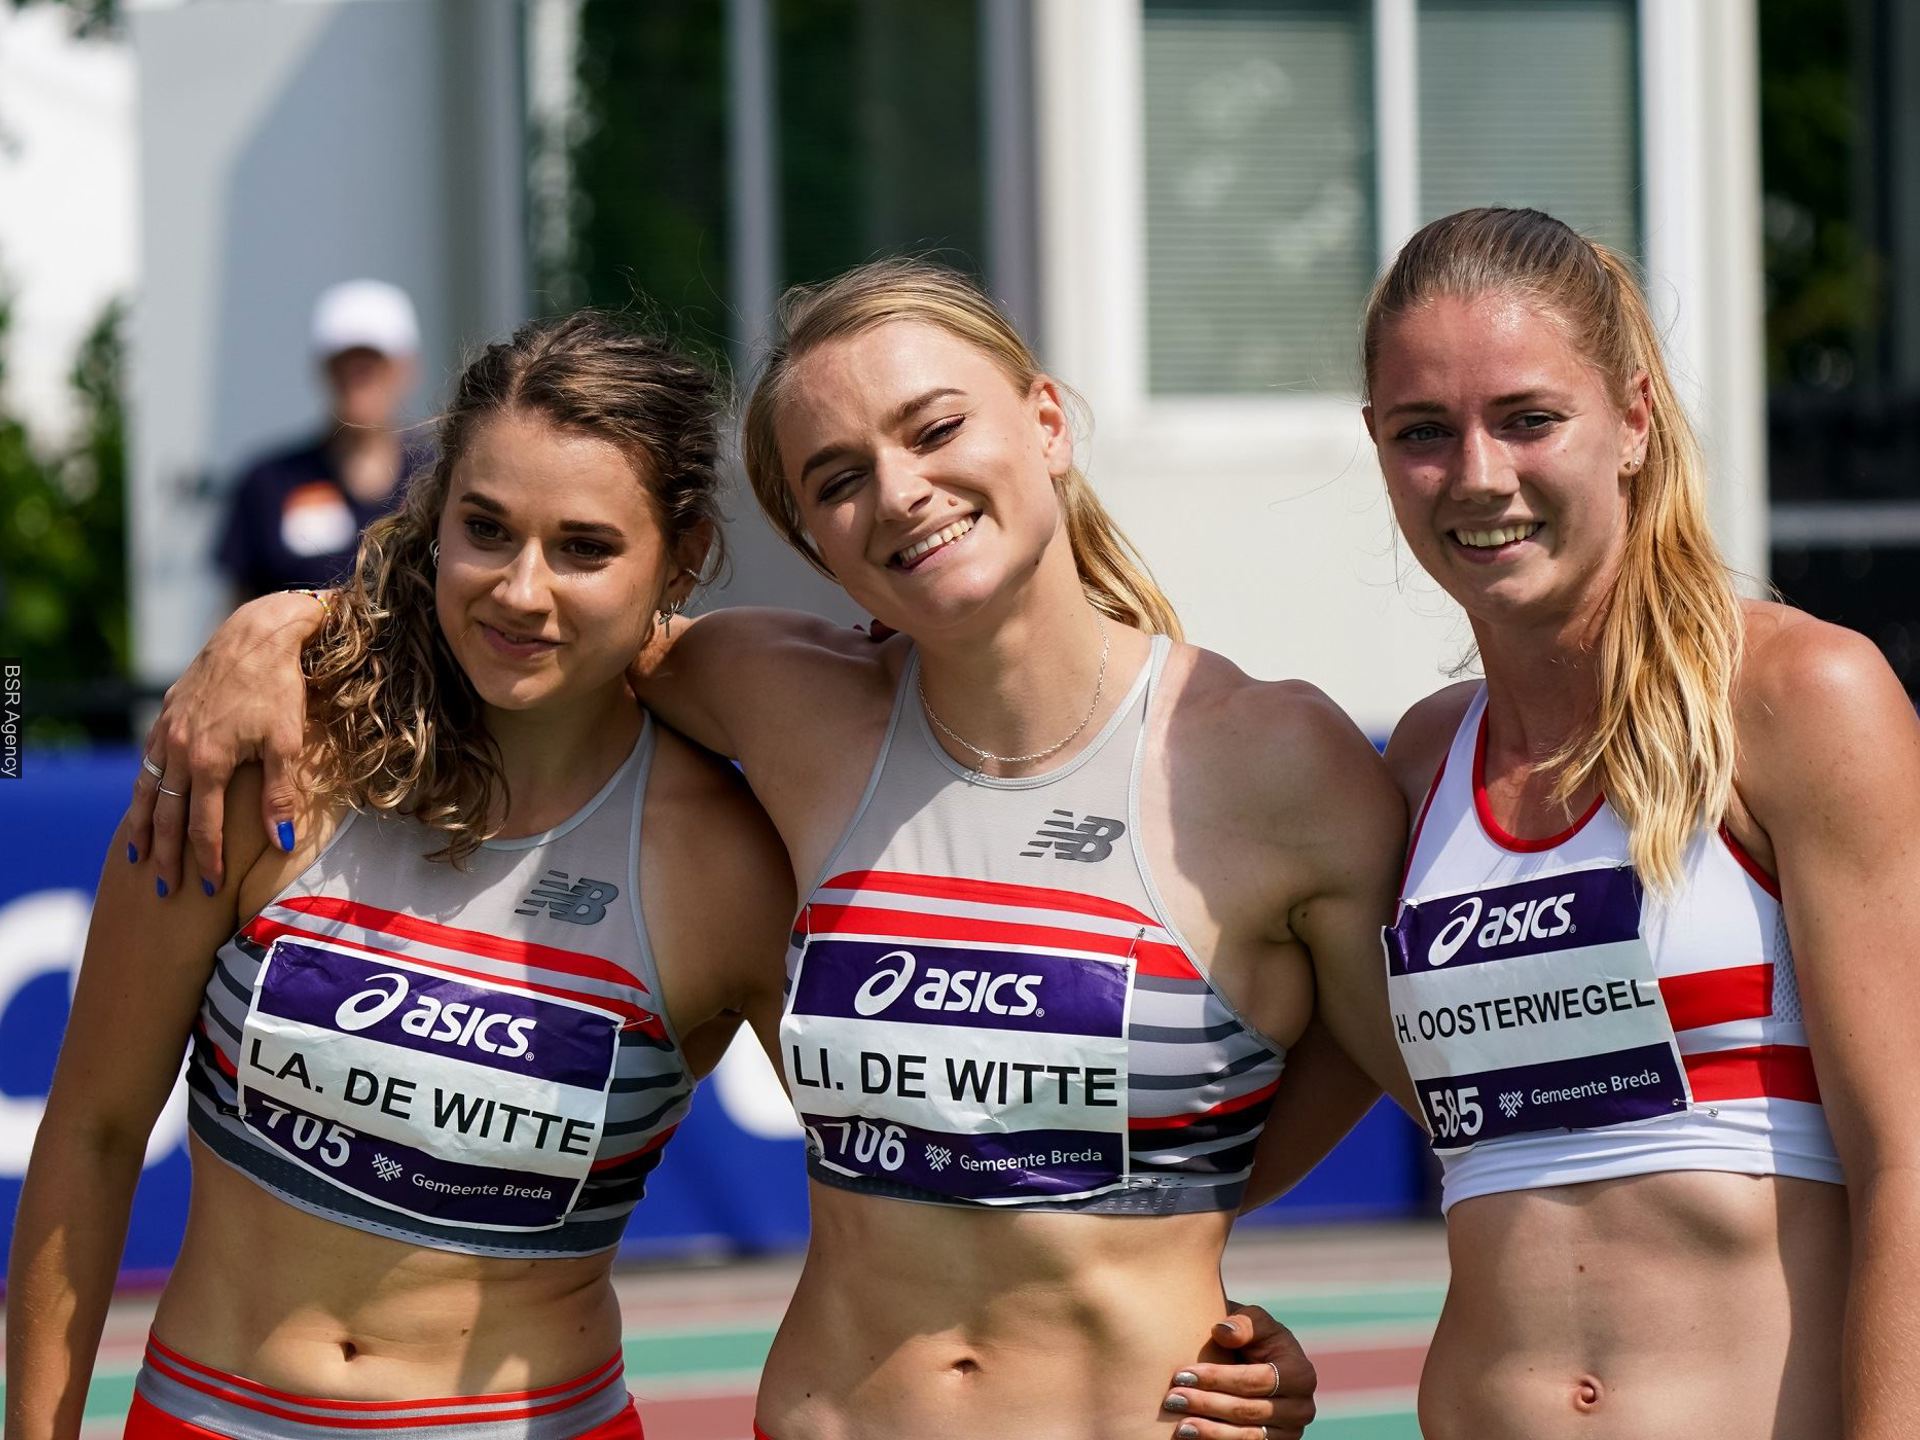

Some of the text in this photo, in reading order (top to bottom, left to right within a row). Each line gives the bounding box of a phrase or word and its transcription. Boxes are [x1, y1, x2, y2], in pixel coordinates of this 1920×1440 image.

[1395, 979, 1656, 1044] H. OOSTERWEGEL
[249, 1038, 596, 1157] LA. DE WITTE
[792, 1044, 1118, 1107] LI. DE WITTE
[1531, 1069, 1661, 1106] Gemeente Breda
[261, 1099, 356, 1168] 705
[1428, 1086, 1484, 1139] 585
[821, 1120, 908, 1172] 706
[959, 1146, 1103, 1173] Gemeente Breda
[411, 1172, 553, 1200] Gemeente Breda
